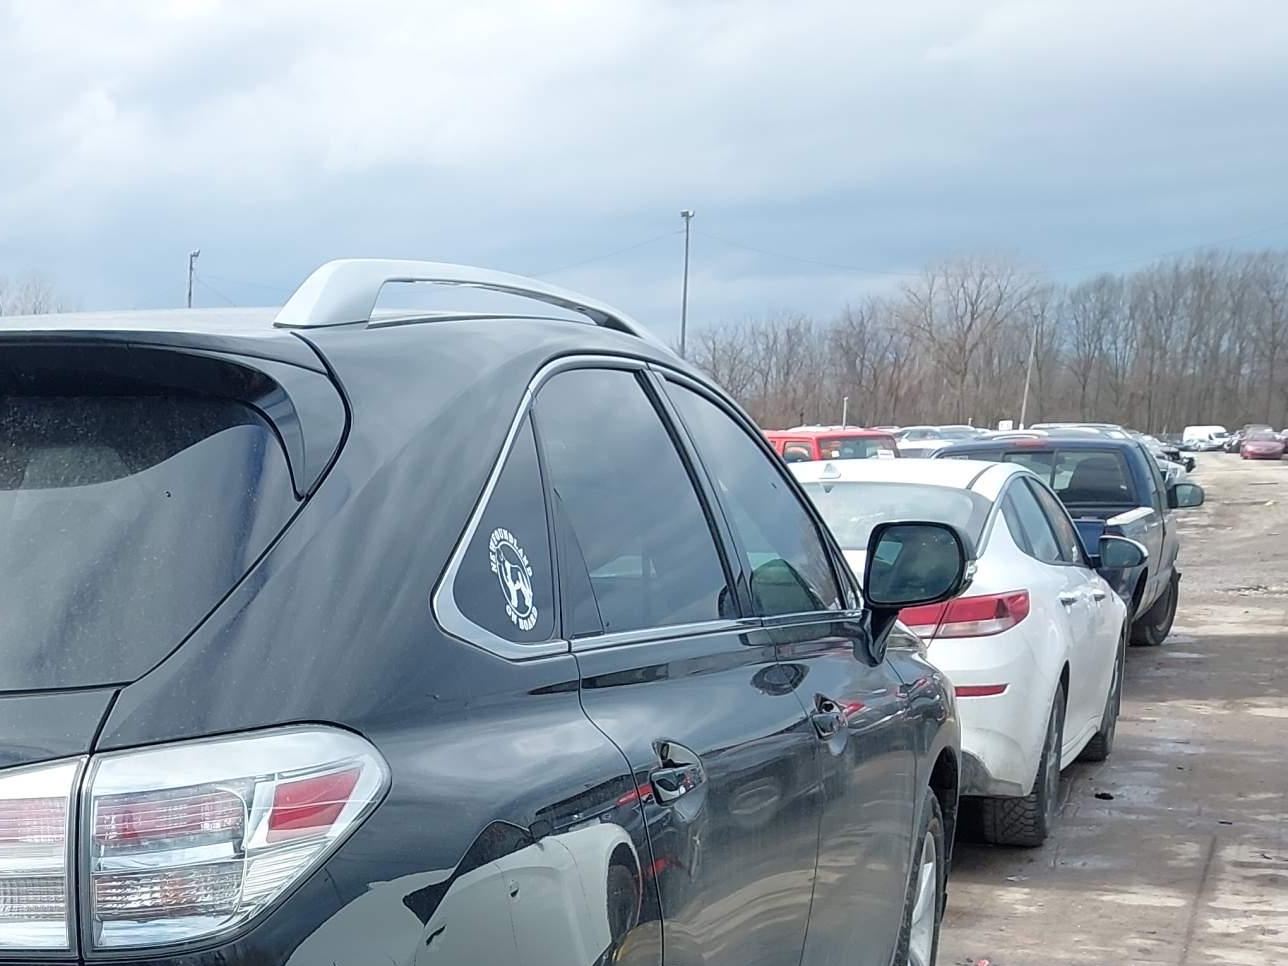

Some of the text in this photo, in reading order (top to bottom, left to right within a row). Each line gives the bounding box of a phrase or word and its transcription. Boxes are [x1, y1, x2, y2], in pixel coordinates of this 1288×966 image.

[489, 527, 533, 578] NEWFOUNDLAND
[506, 604, 539, 631] ON BOARD
